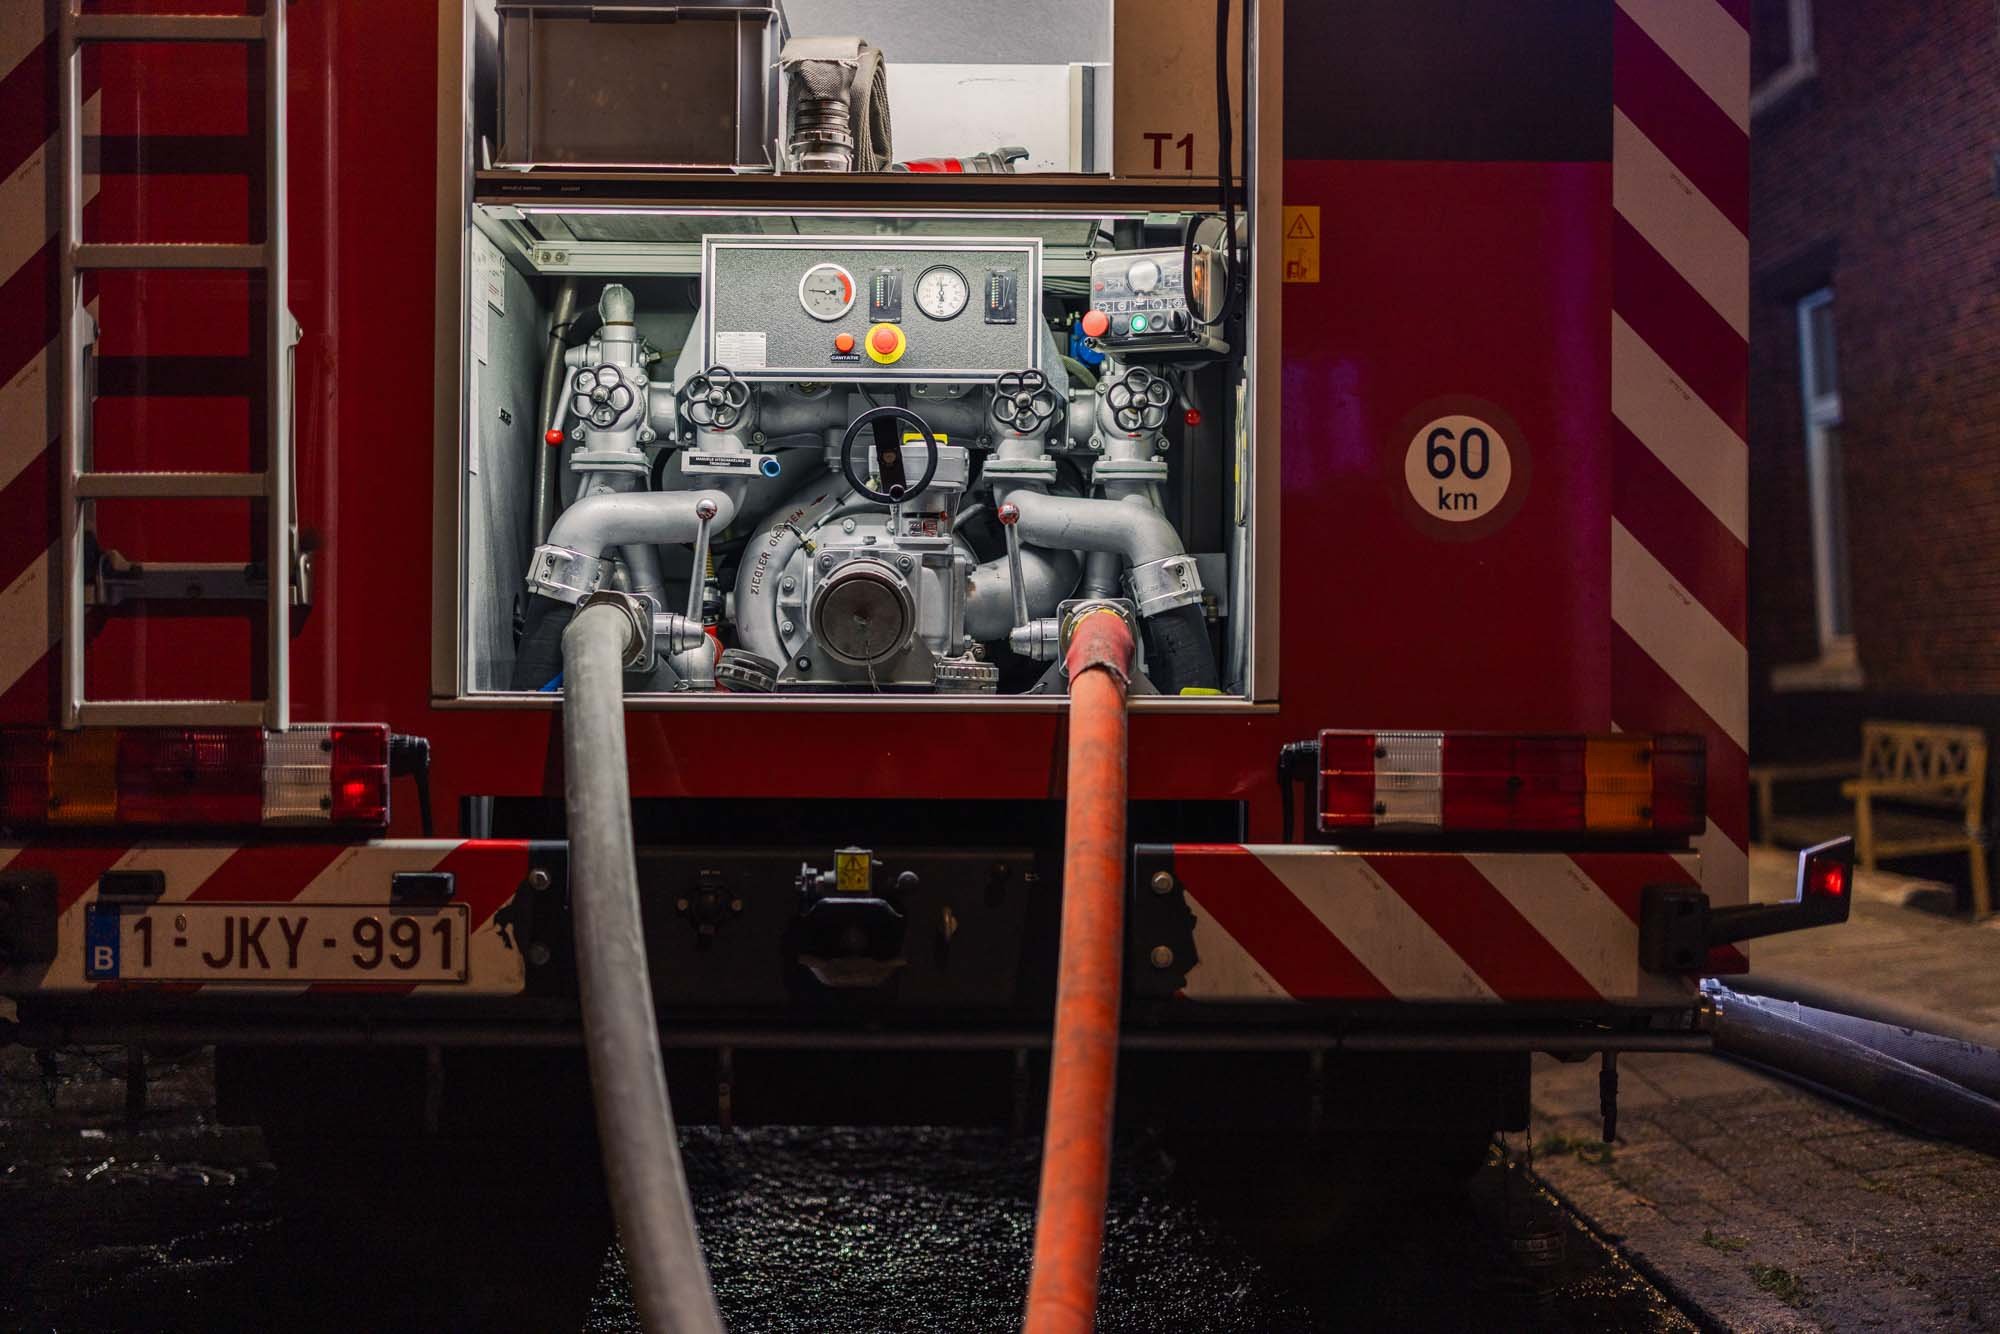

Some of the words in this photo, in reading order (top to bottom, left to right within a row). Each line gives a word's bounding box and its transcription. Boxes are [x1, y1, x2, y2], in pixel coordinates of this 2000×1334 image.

[1143, 132, 1194, 170] T1
[1426, 427, 1490, 480] 60
[1438, 486, 1478, 511] km
[750, 551, 771, 595] ZIEGLER
[94, 945, 114, 971] B
